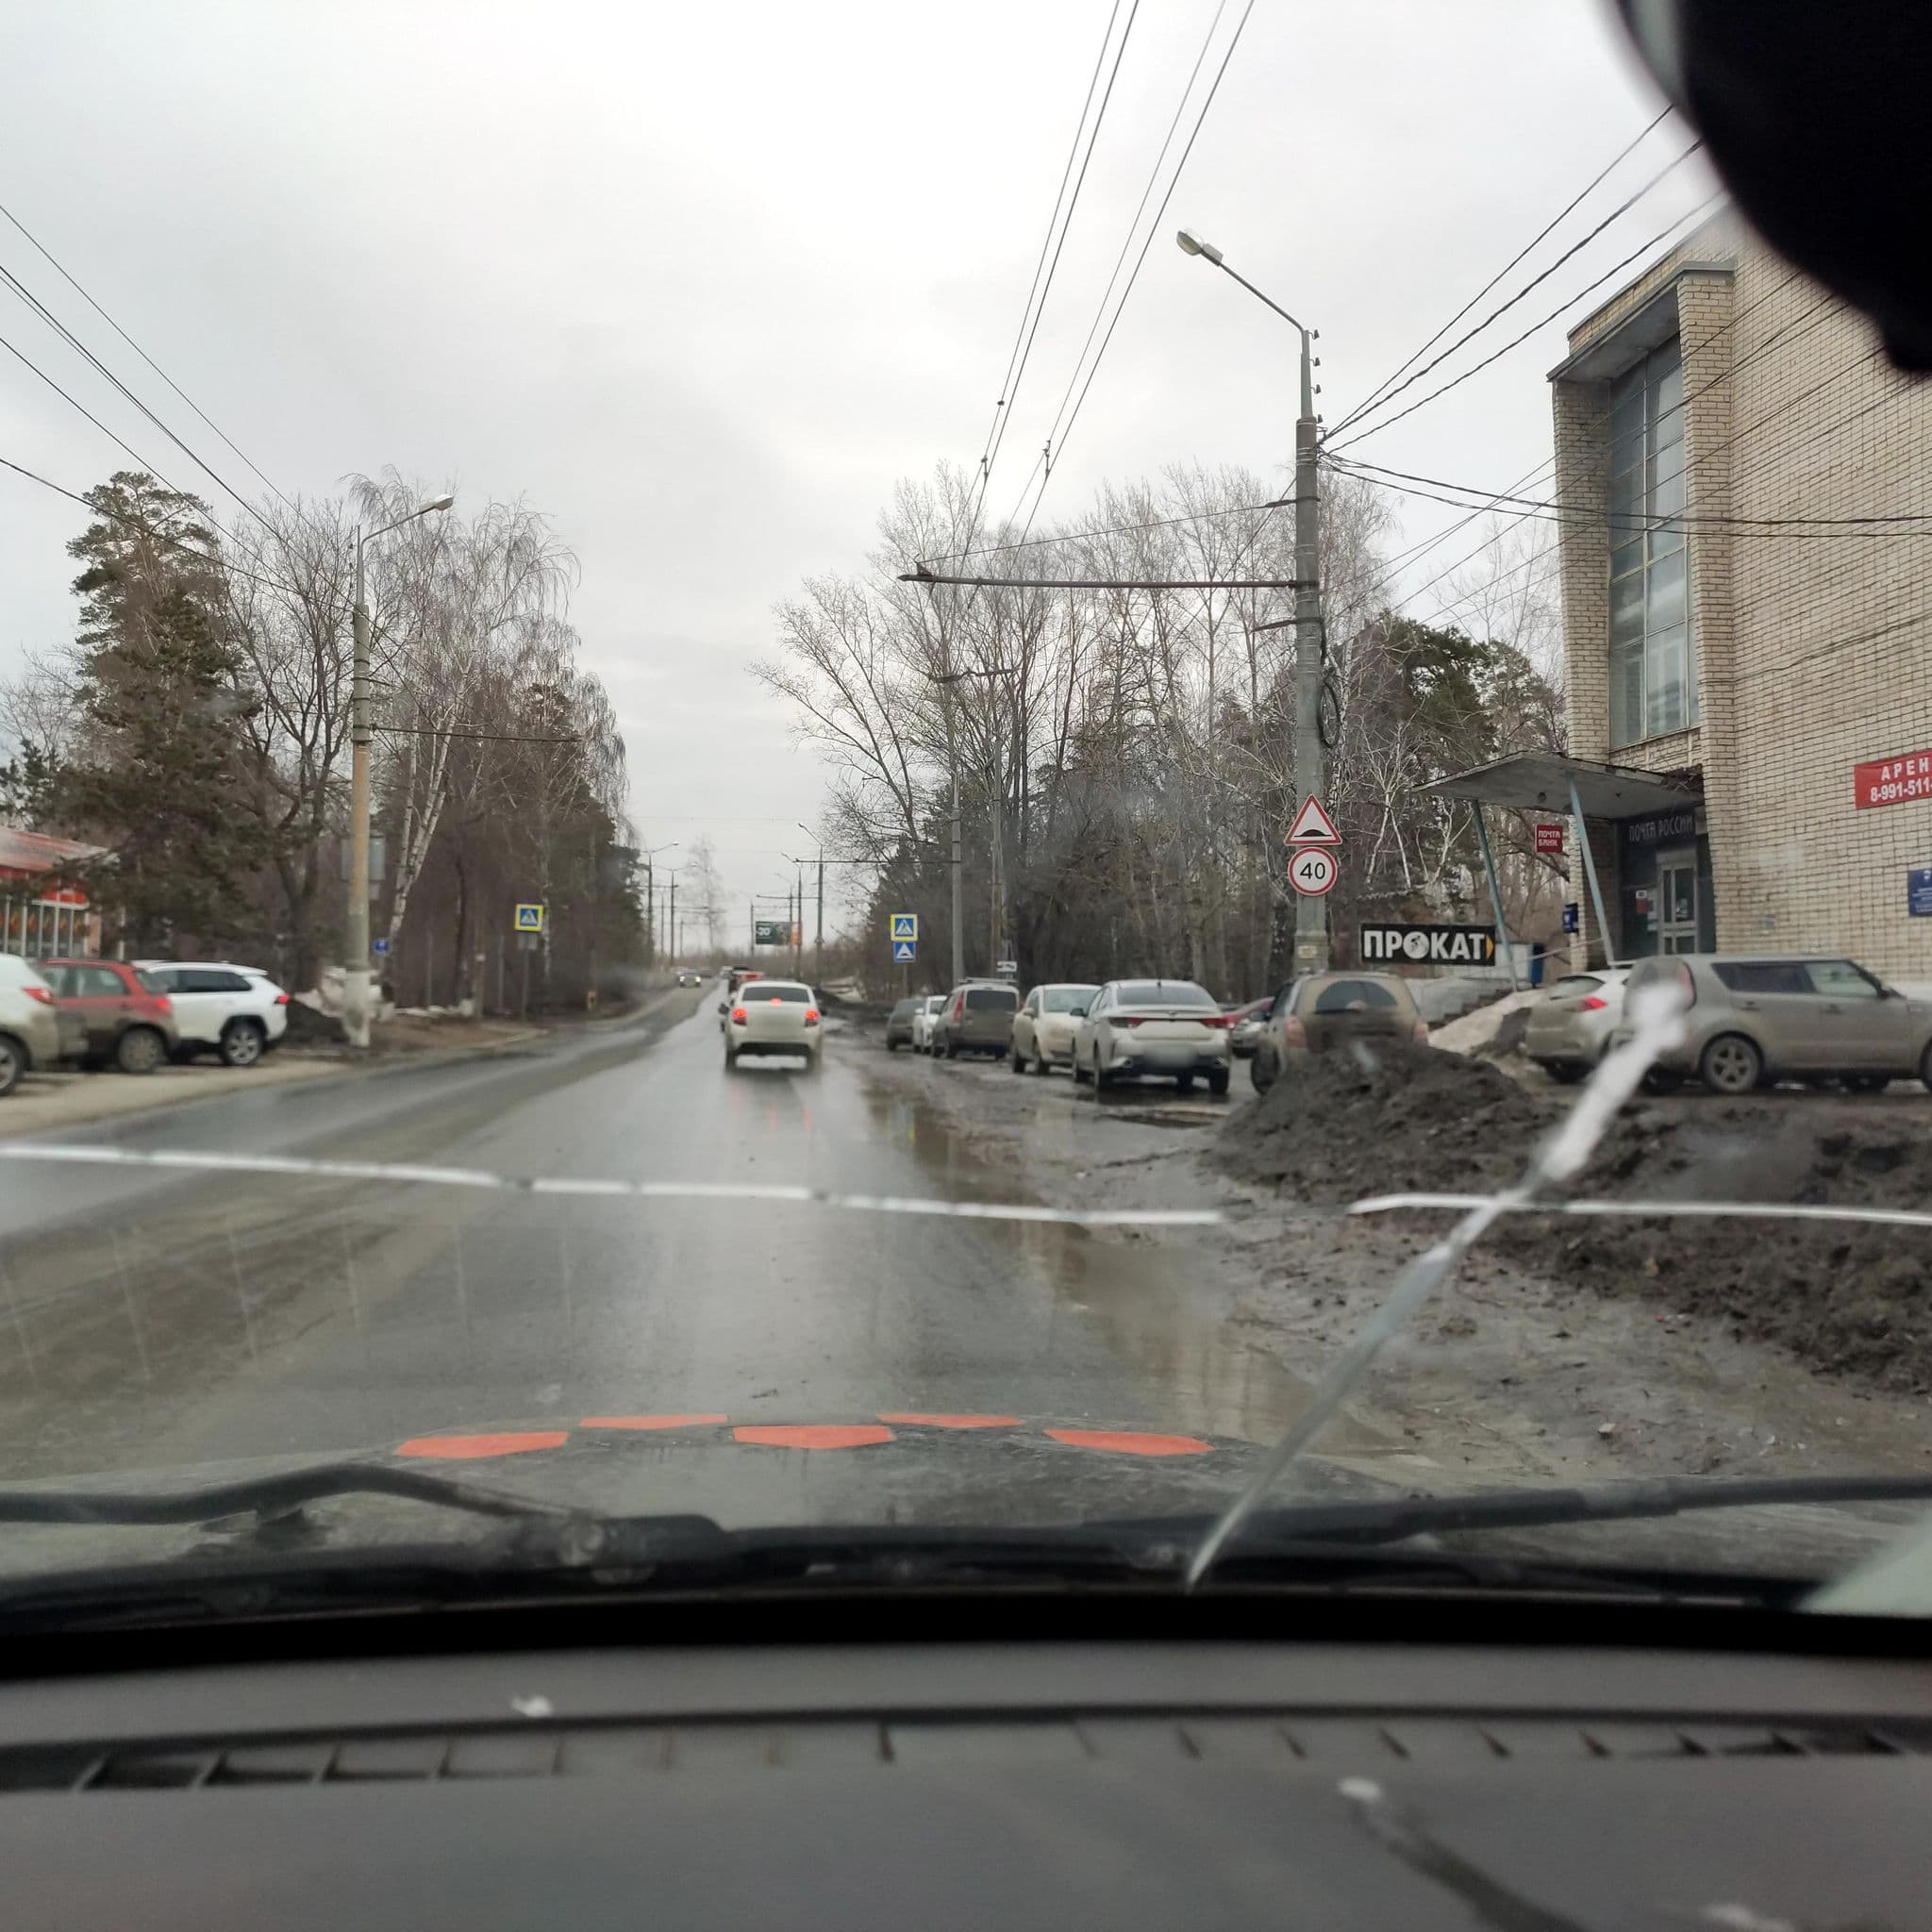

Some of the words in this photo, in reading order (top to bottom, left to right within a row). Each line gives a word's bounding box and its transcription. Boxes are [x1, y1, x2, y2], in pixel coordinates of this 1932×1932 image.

[1881, 758, 1929, 781] АРЕН
[1300, 862, 1325, 879] 40
[1363, 930, 1485, 960] ПРОКАТ
